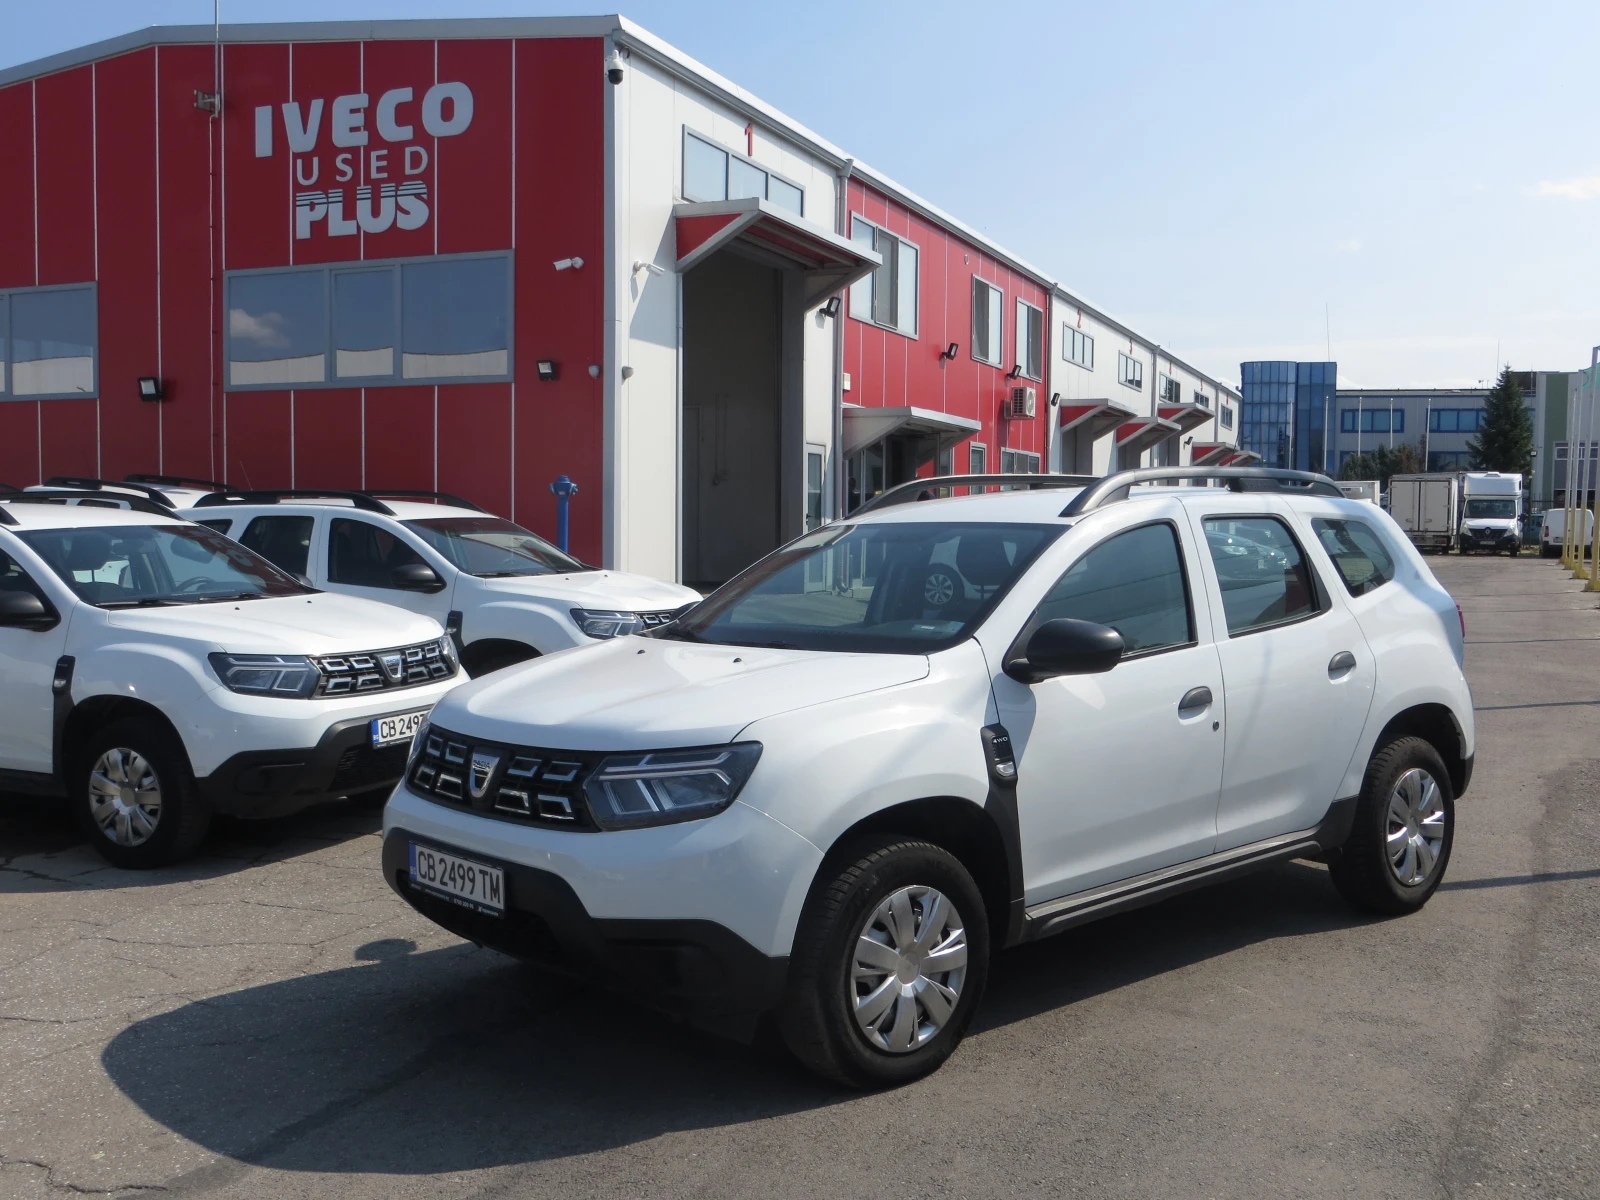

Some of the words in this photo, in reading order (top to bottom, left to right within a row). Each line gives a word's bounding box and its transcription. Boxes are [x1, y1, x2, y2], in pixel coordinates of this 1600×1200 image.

[254, 81, 474, 158] IVECO
[745, 122, 753, 157] 1
[296, 146, 428, 186] USED
[296, 180, 430, 240] PLUS
[380, 721, 397, 739] CB
[418, 851, 436, 882] CB
[439, 857, 476, 895] 2499
[479, 868, 500, 904] TM
